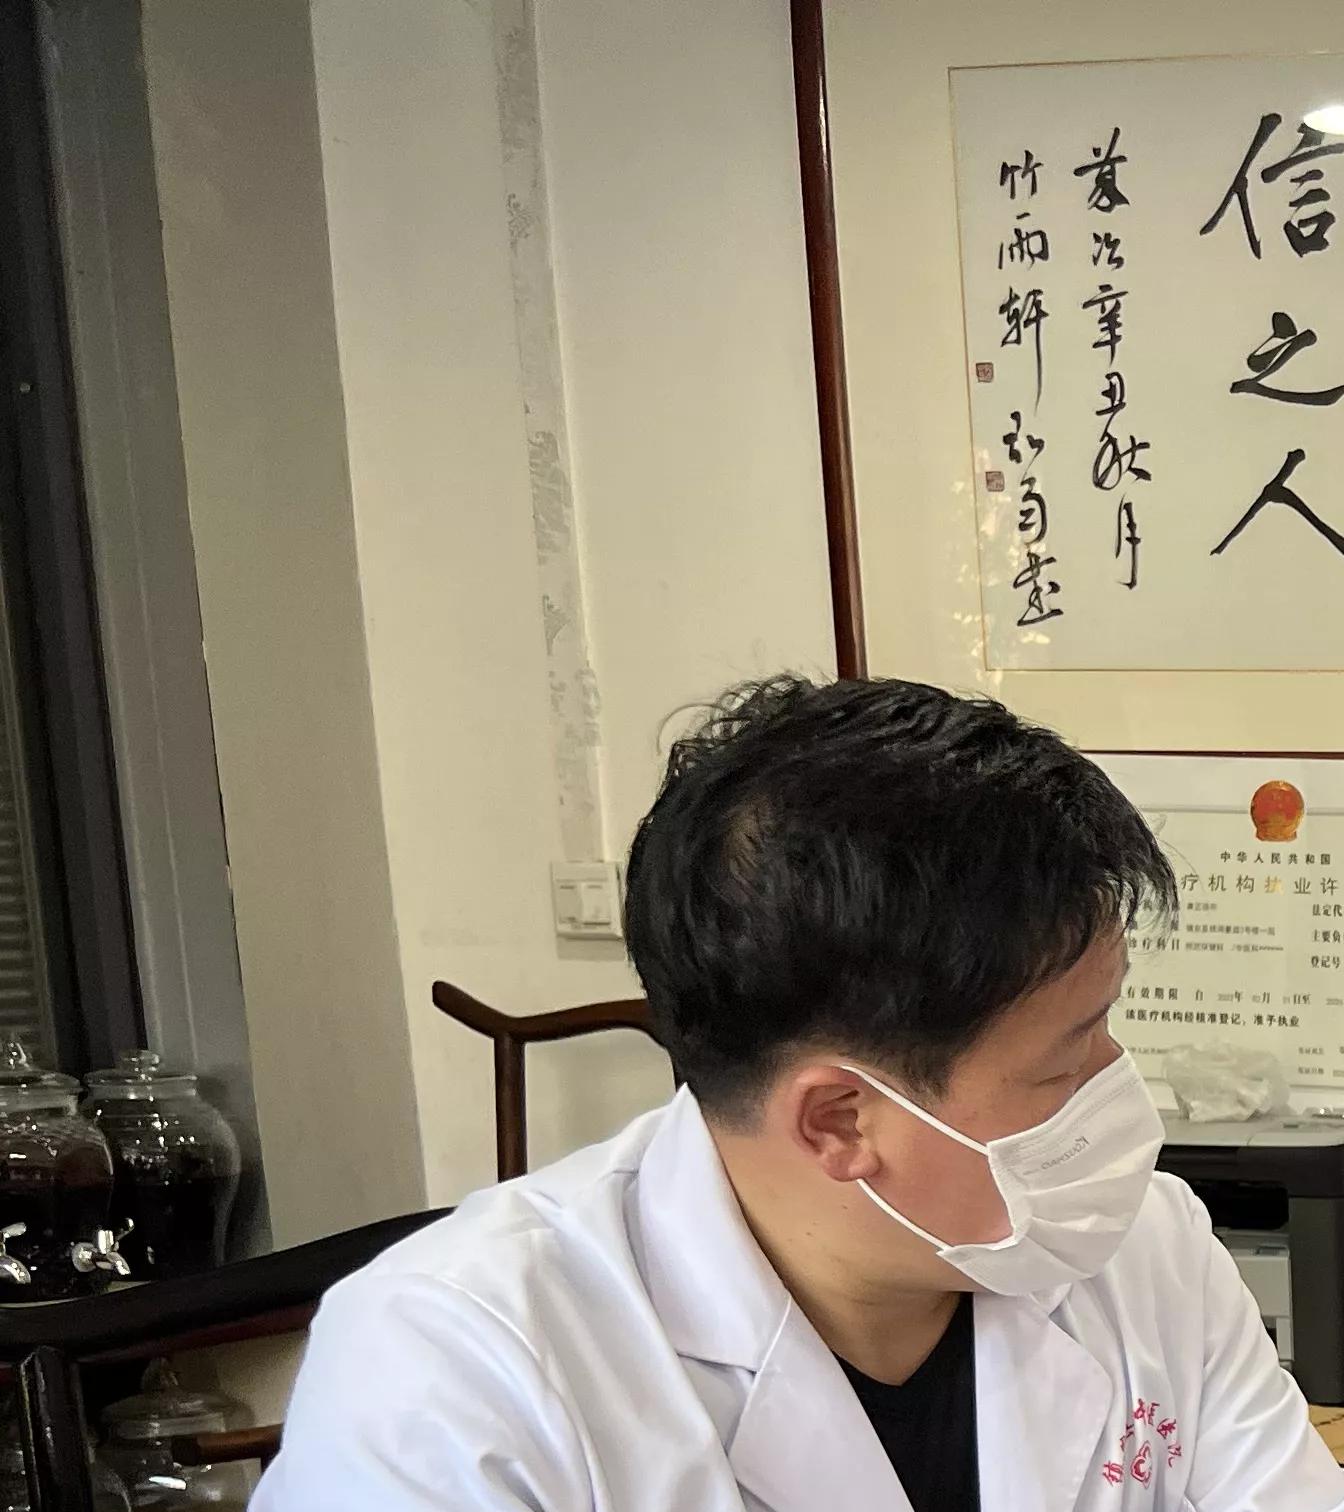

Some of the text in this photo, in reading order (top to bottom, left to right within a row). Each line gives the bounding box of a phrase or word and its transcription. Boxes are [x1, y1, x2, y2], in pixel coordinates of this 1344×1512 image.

[1220, 850, 1331, 866] 中华人民共和国
[1311, 955, 1341, 969] 登记号
[1127, 985, 1178, 1000] 有效期限
